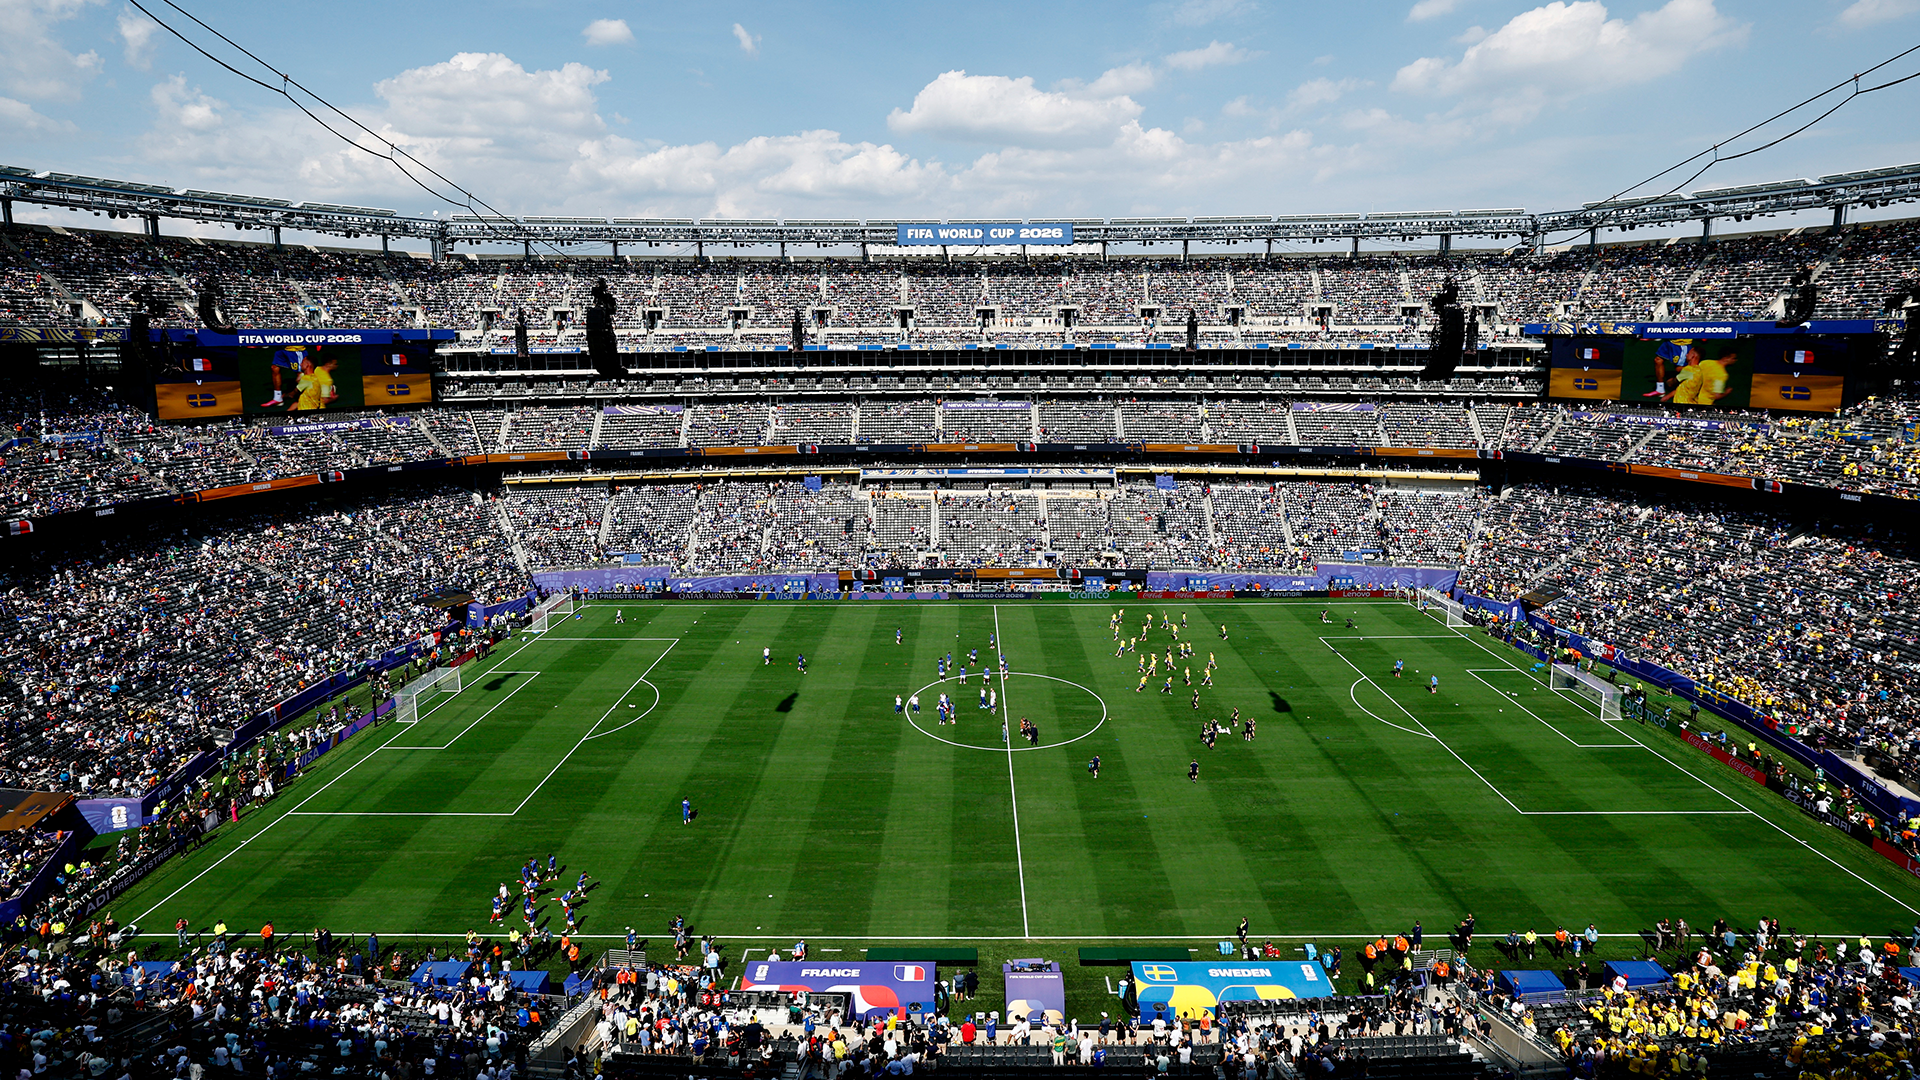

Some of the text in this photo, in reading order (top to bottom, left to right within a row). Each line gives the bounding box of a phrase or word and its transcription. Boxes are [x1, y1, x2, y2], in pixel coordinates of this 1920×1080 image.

[907, 228, 1064, 239] FIFA WORLD CUP 2026
[238, 334, 362, 344] FIFA WORLD CUP 2026
[1840, 493, 1862, 502] FRANCE
[95, 508, 115, 517] FRANCE
[1535, 622, 1545, 631] FIFA
[1524, 643, 1538, 658] VISA
[1624, 698, 1667, 728] aramco
[1687, 734, 1712, 754] Coca-Cola
[1728, 757, 1755, 780] Coca-Cola
[158, 786, 172, 800] FIFA
[1862, 780, 1878, 796] FIFA
[86, 843, 178, 916] ADI PREDICTSTREET
[800, 968, 860, 977] FRANCE
[1208, 968, 1272, 978] SWEDEN
